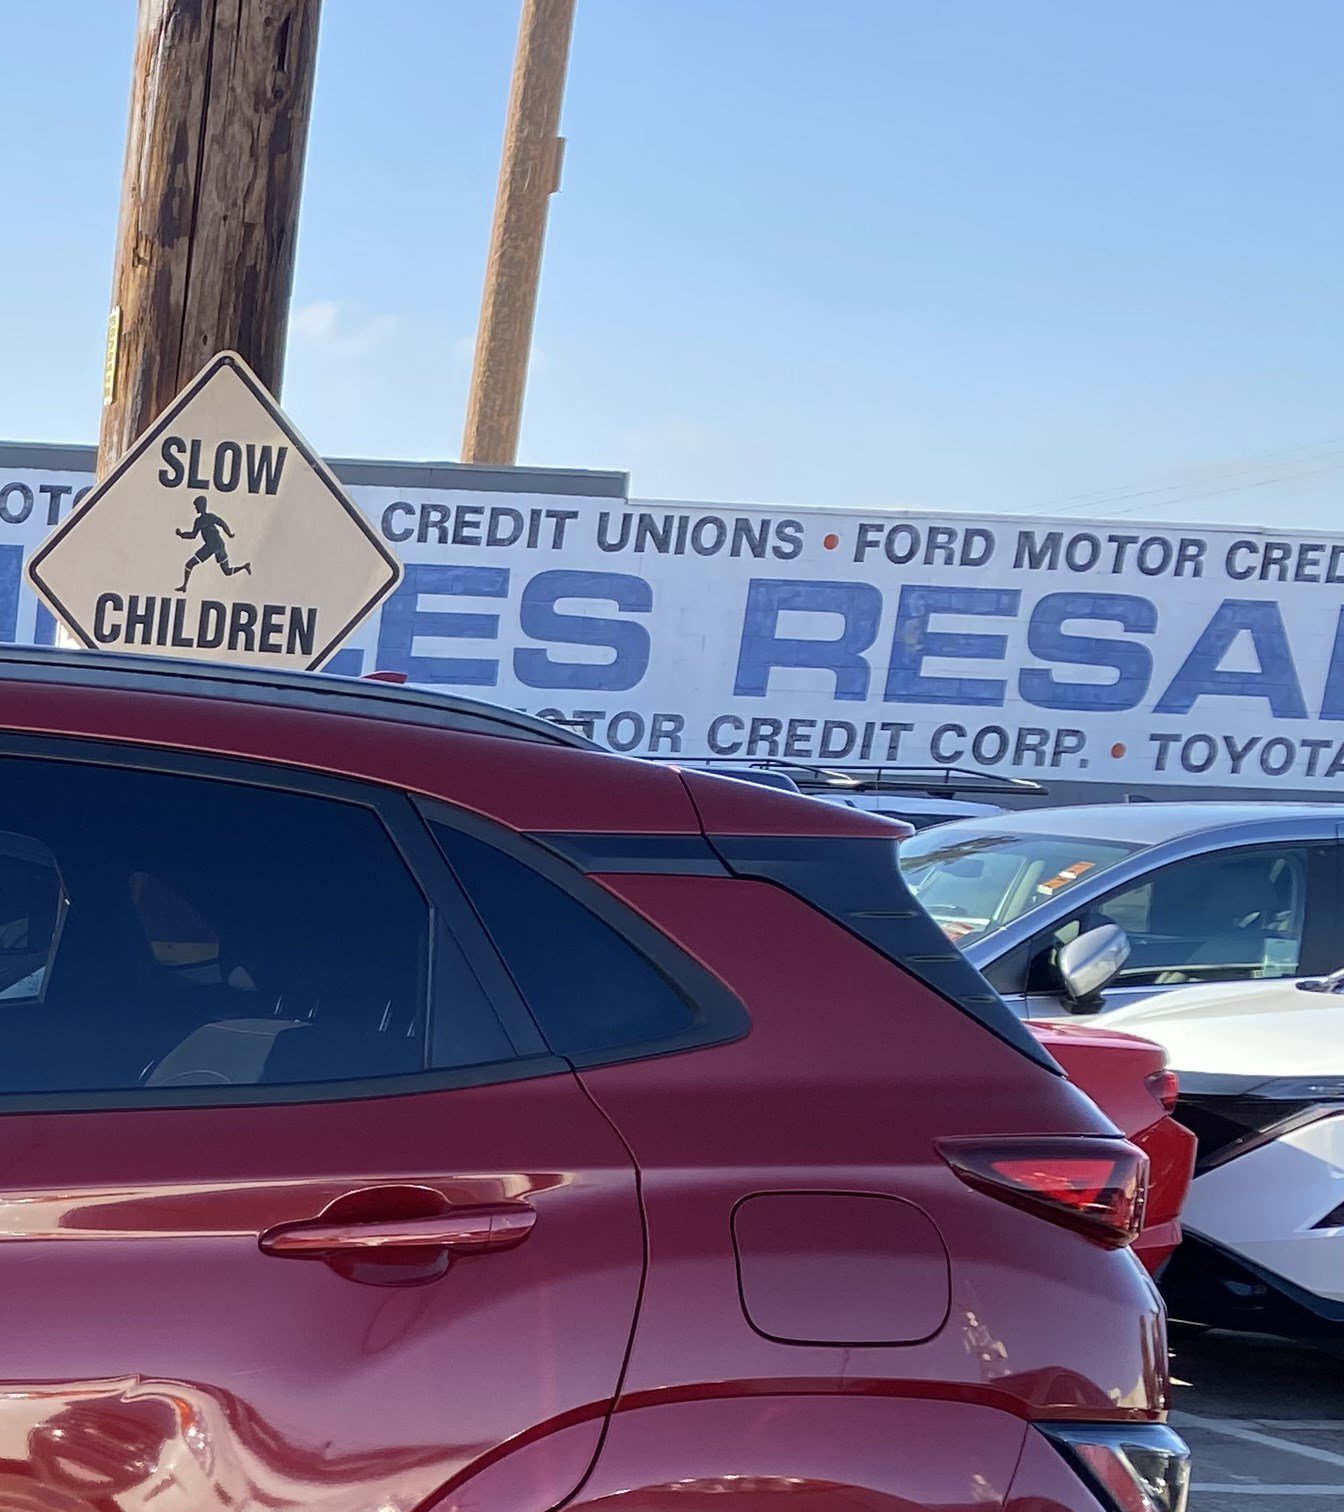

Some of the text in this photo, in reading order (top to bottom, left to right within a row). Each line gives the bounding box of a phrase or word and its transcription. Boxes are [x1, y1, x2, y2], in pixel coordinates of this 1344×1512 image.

[158, 436, 289, 496] SLOW
[382, 501, 579, 551] CREDIT
[597, 509, 804, 560] UNIONS
[853, 523, 996, 567] FORD
[1013, 530, 1208, 578] MOTOR
[93, 592, 318, 656] CHILDREN
[732, 577, 1344, 720] RESA
[706, 714, 915, 761] CREDIT
[929, 723, 1089, 769] CORP.
